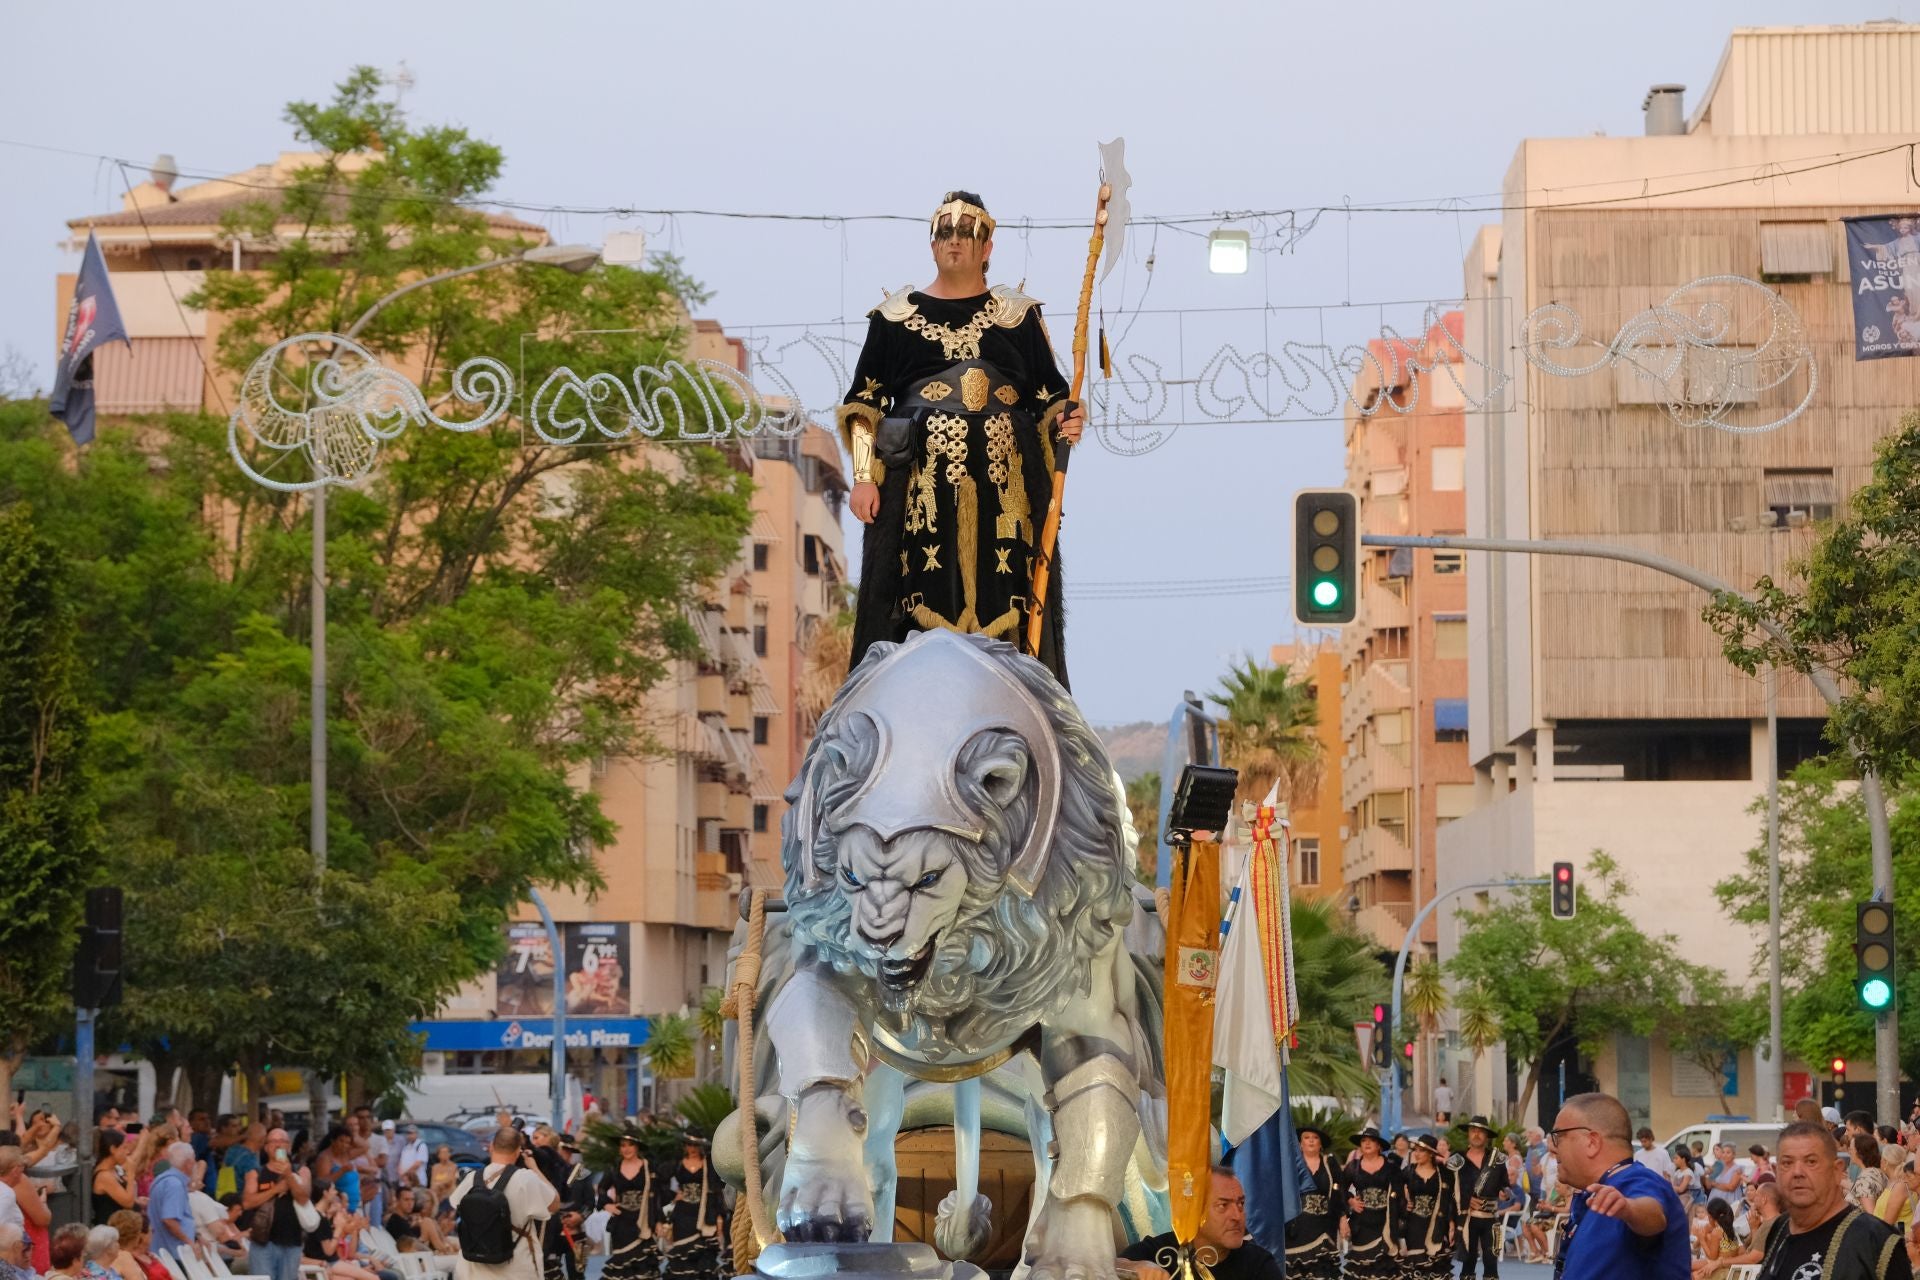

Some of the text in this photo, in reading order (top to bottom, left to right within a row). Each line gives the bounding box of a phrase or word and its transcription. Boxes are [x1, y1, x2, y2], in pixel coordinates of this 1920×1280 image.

[1861, 256, 1919, 270] VIRGEN
[1862, 343, 1892, 352] MOROS
[591, 1028, 630, 1046] Pizza
